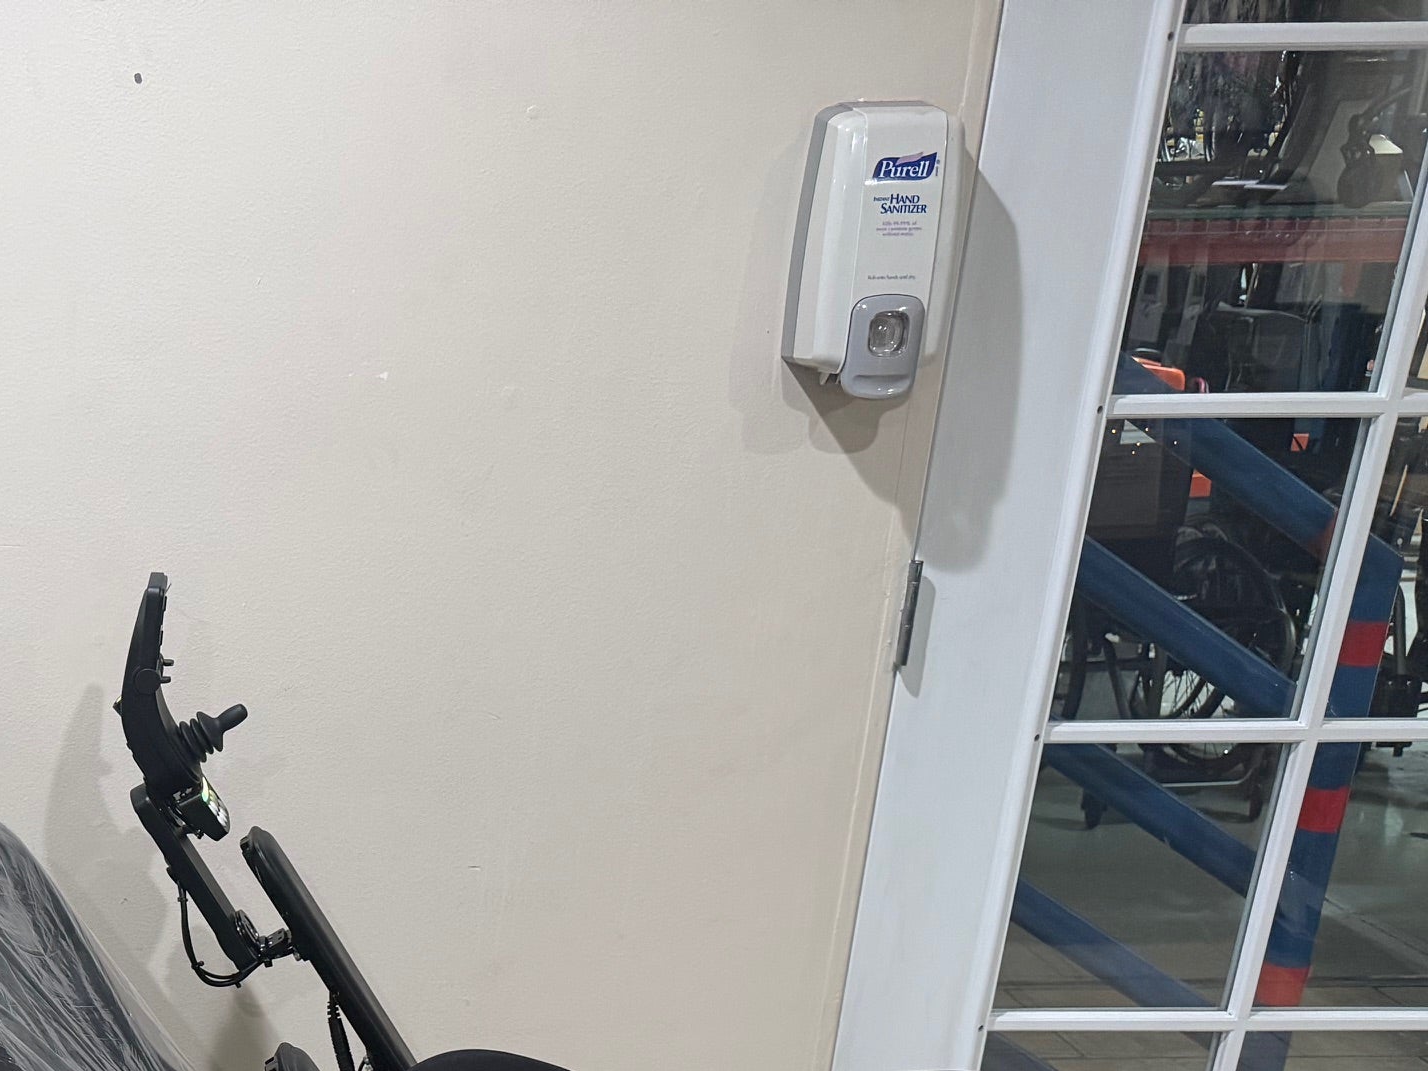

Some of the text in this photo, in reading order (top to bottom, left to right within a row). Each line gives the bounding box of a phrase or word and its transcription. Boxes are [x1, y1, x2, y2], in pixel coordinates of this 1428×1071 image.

[878, 160, 930, 178] Purell
[890, 193, 920, 205] HAND
[880, 202, 927, 214] SANITIZER
